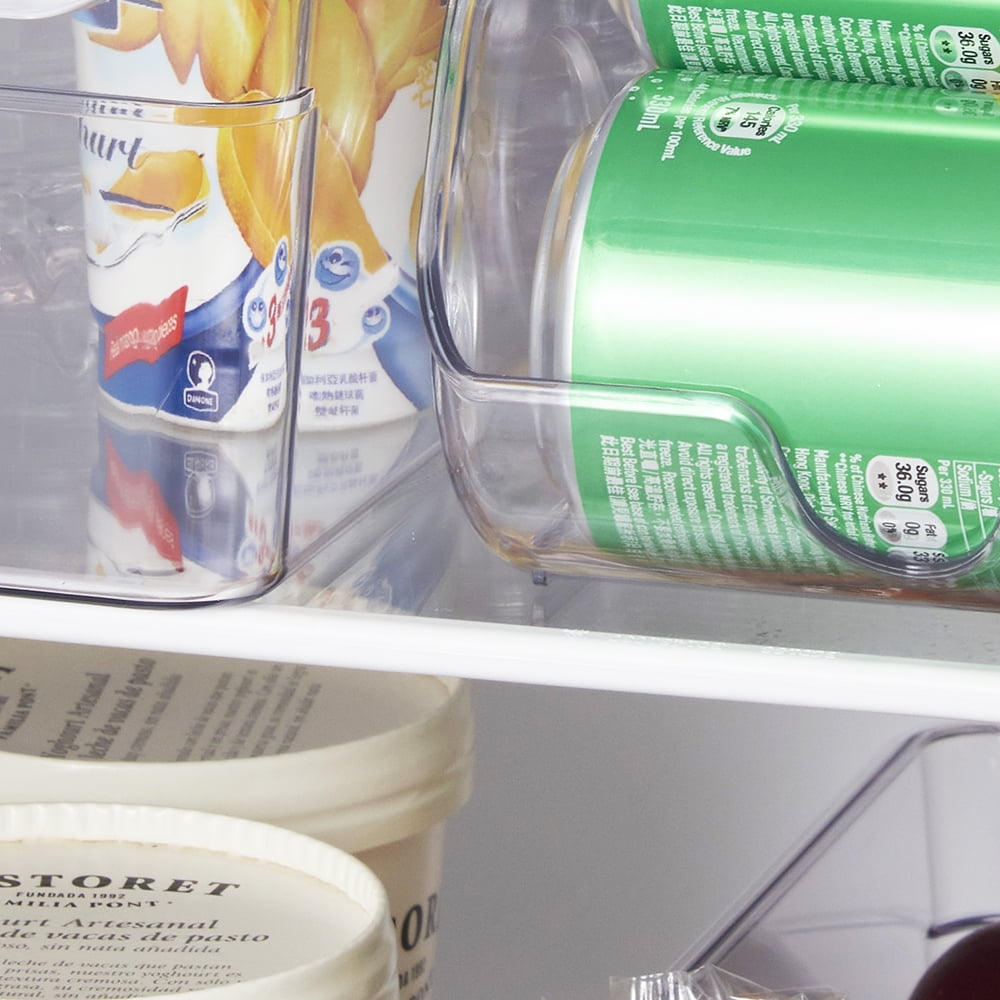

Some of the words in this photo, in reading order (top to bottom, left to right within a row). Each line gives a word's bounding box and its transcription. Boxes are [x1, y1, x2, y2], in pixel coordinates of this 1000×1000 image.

[687, 6, 702, 22] Best
[744, 10, 761, 30] Avoid
[763, 11, 778, 22] All
[691, 23, 709, 44] Before
[764, 22, 781, 41] rights
[840, 17, 857, 51] Coca-Cola
[858, 19, 873, 36] Hong
[915, 32, 926, 41] of
[749, 31, 766, 50] direct
[877, 20, 901, 66] Manufactured
[957, 31, 978, 65] 36.0g
[978, 33, 994, 65] Sugars
[917, 41, 931, 63] Chinese
[636, 94, 674, 131] 330mL
[739, 112, 758, 129] 145
[756, 106, 781, 137] Calories
[661, 130, 683, 161] 100mL
[768, 131, 787, 144] mL
[720, 144, 751, 157] Value
[620, 436, 636, 457] Best
[659, 440, 674, 467] freeze.
[678, 441, 693, 466] Avoid
[697, 442, 712, 455] All
[695, 456, 713, 479] rights
[795, 448, 809, 469] Hong
[937, 459, 950, 476] Per
[623, 458, 638, 484] Before
[680, 467, 697, 490] direct
[714, 451, 736, 494] registered
[735, 446, 755, 496] trademarks
[815, 449, 834, 507] Manufactured
[850, 465, 863, 474] of
[852, 474, 865, 505] Chinese
[895, 462, 914, 503] 36.0g
[916, 465, 930, 504] Sugars
[939, 476, 953, 493] 330
[957, 464, 973, 497] Sodium
[978, 470, 993, 504] -Sugars
[702, 480, 719, 514] reserved.
[839, 496, 853, 511] NRV
[942, 494, 955, 509] mL
[820, 507, 836, 516] by
[904, 521, 920, 536] 0g
[925, 523, 937, 537] Fat
[0, 874, 241, 897] STORET
[16, 891, 86, 899] FUNDADA
[61, 918, 220, 929] Artesanal
[0, 929, 37, 939] de
[46, 933, 132, 941] vacas
[140, 932, 177, 942] de
[185, 934, 271, 944] pasto
[40, 943, 71, 951] sin
